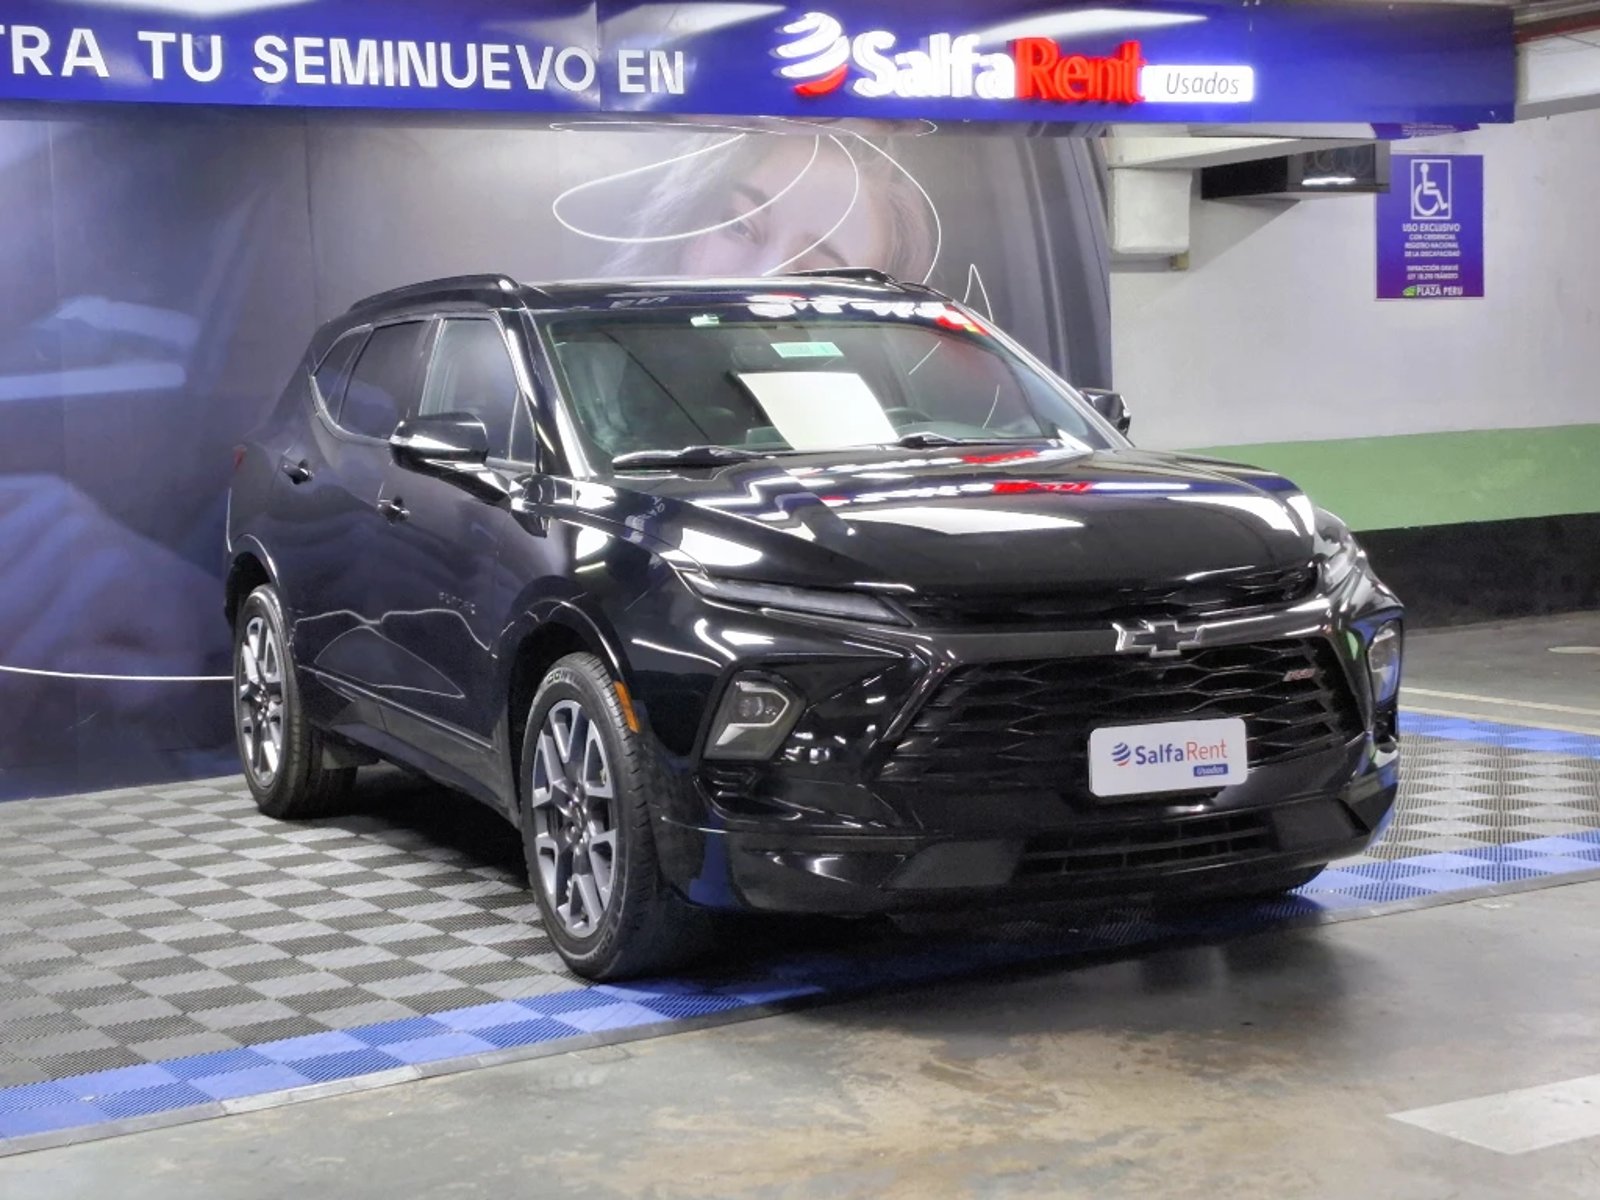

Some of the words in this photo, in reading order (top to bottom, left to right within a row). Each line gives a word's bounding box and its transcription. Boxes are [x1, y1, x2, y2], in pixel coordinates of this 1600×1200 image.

[0, 25, 110, 77] RA
[137, 30, 223, 82] TU
[252, 35, 596, 92] SEMINUEVO
[618, 49, 686, 94] EN
[851, 30, 1145, 104] SalfaRent
[1166, 71, 1239, 95] Usados
[1402, 223, 1418, 232] USO
[1420, 223, 1461, 232] EXCLUSIVO
[1416, 286, 1442, 296] PLAZA
[1443, 286, 1463, 296] PERU
[1135, 739, 1228, 765] SalfaRent
